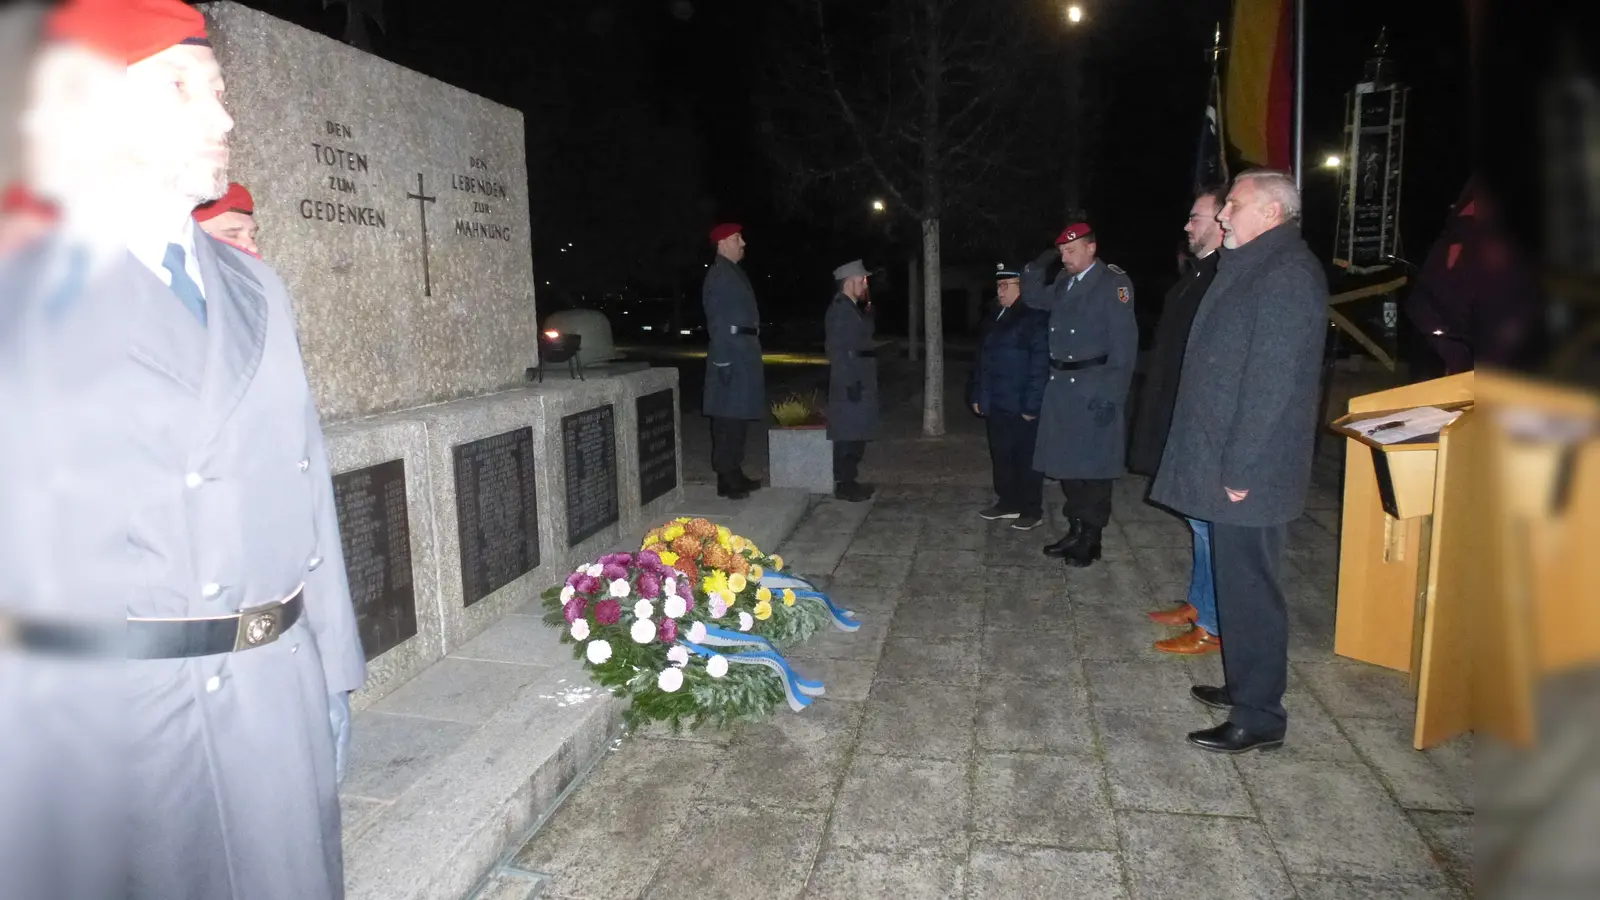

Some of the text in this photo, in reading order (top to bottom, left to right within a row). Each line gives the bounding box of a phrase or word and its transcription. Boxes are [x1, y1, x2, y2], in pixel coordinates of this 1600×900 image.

[326, 120, 351, 138] DEN
[312, 143, 369, 173] TOTEN
[470, 156, 487, 171] DEN
[328, 176, 356, 194] ZUM
[452, 173, 506, 198] LEBENDEN
[300, 199, 386, 229] GEDENKEN
[474, 202, 492, 214] ZUR
[455, 219, 511, 242] MAHNUNG
